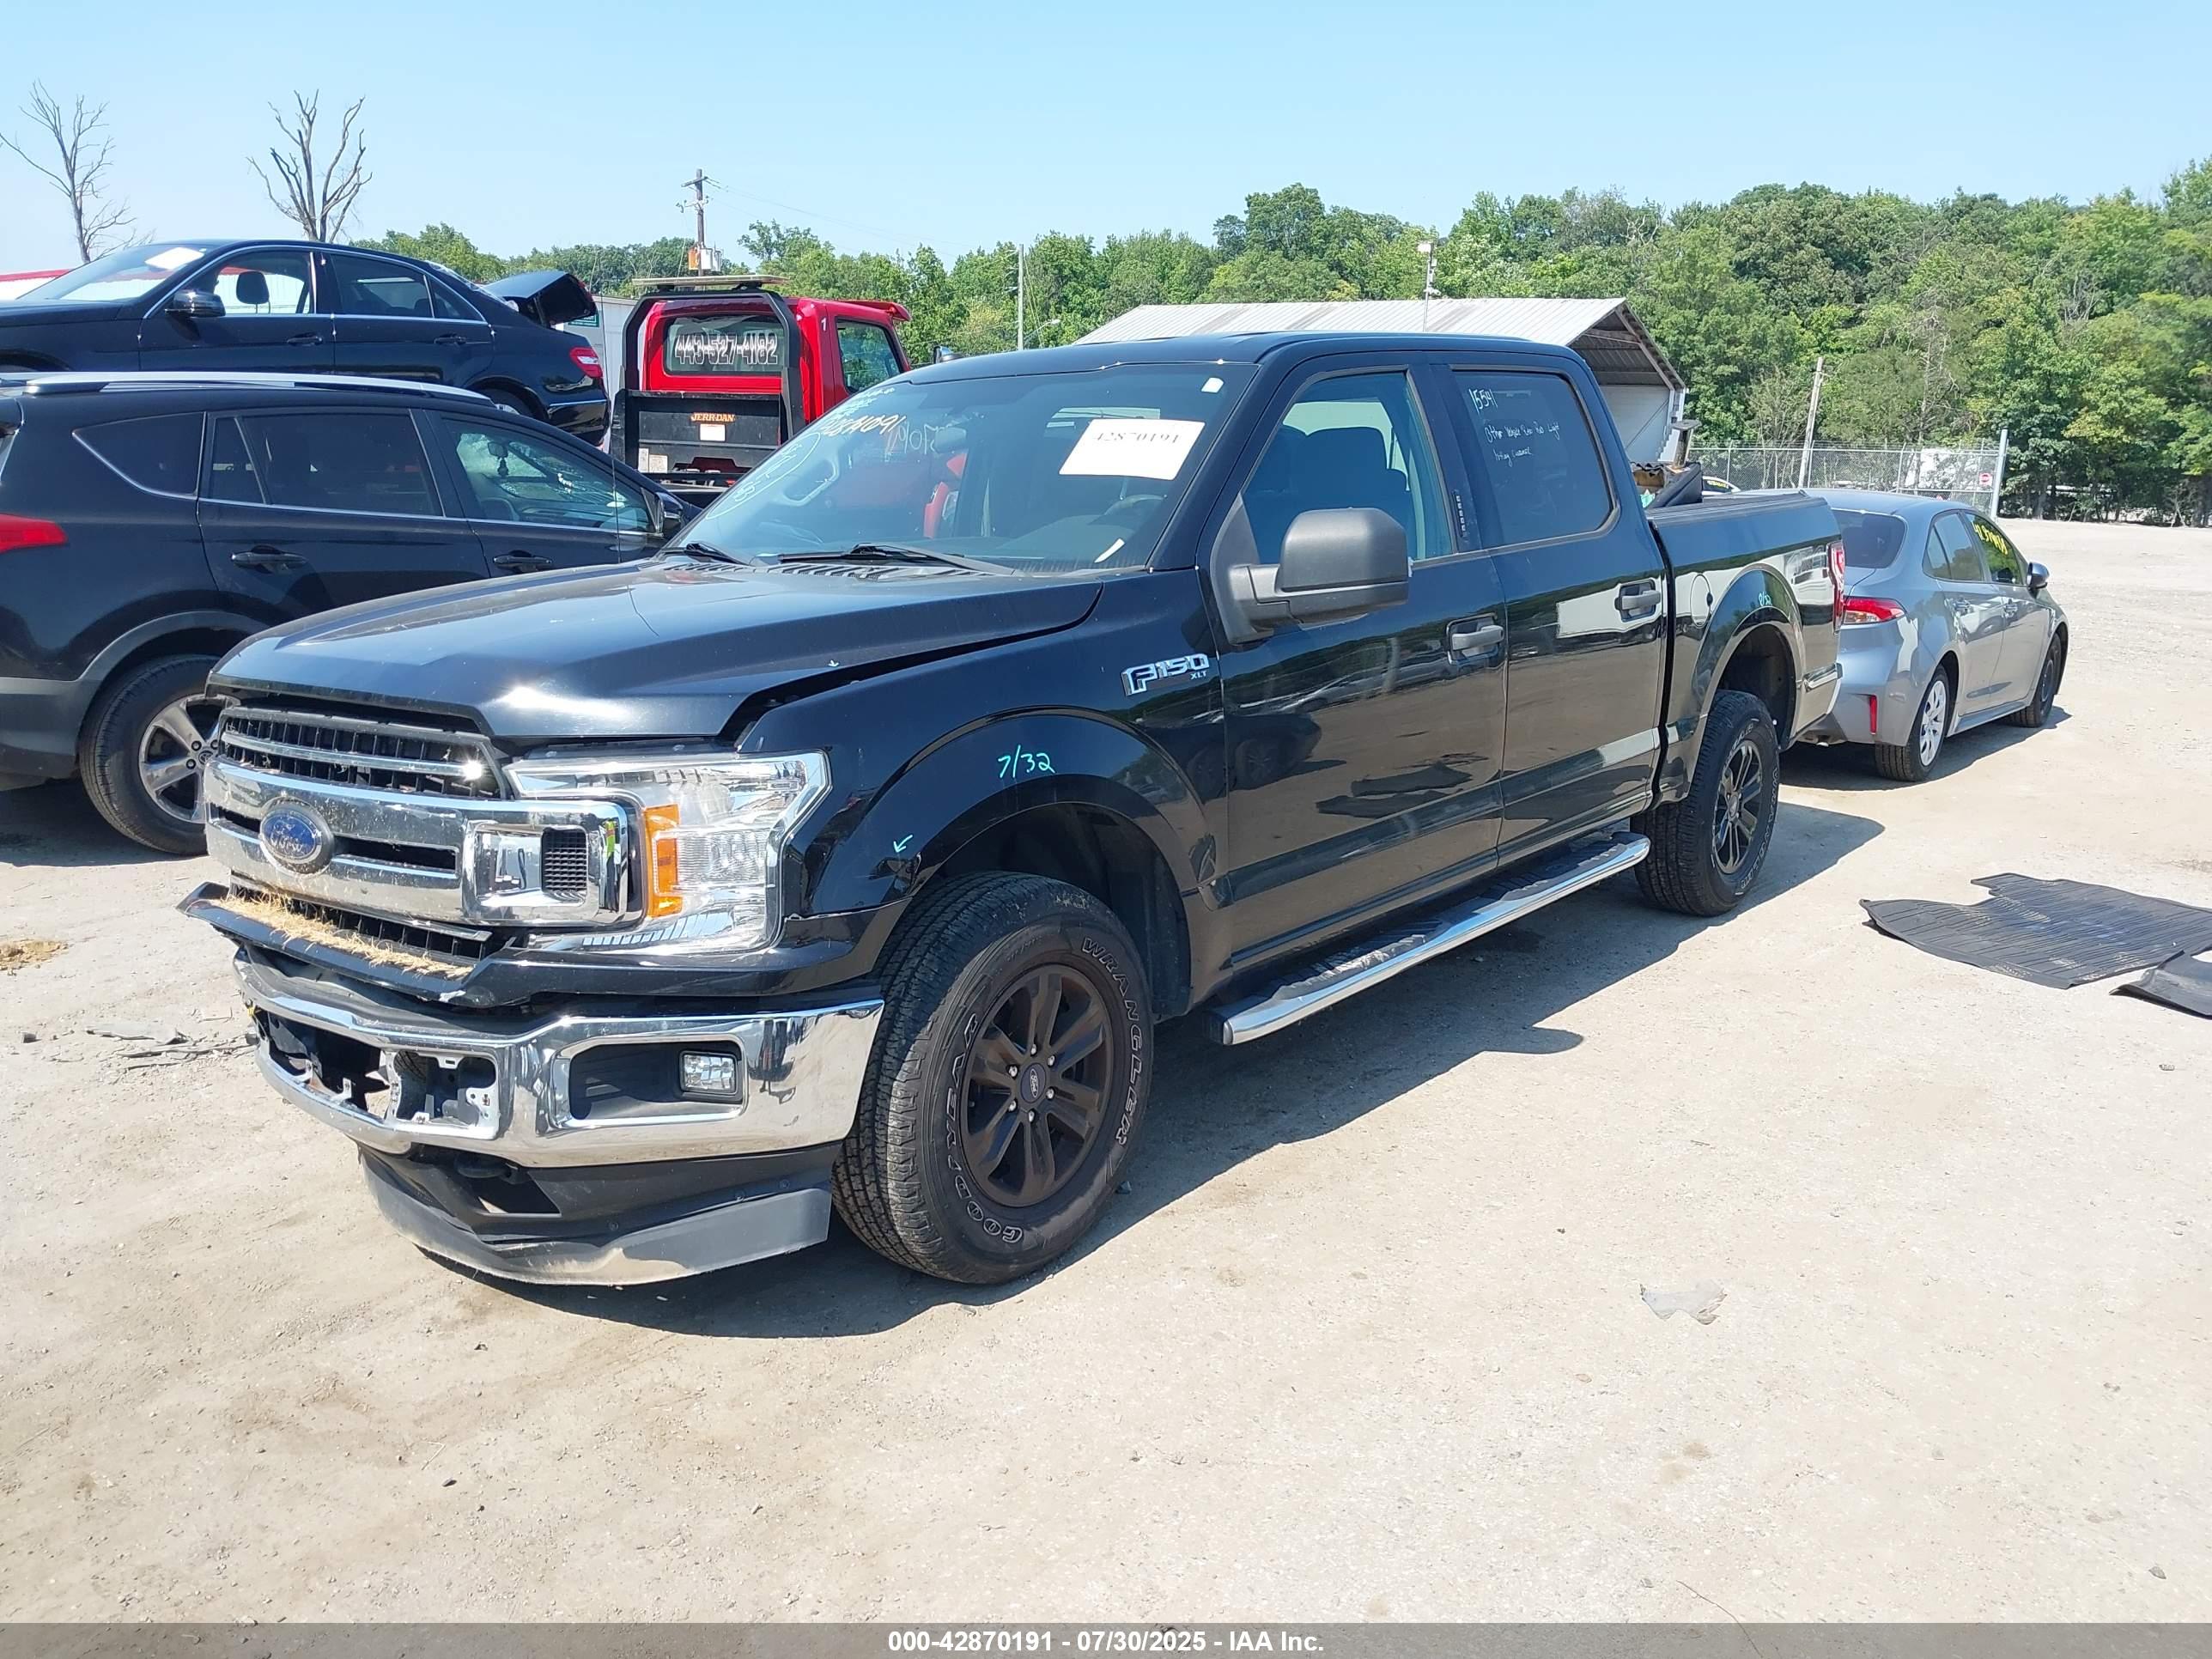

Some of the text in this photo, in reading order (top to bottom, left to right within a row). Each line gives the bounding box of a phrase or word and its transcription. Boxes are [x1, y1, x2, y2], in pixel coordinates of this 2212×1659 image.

[674, 334, 778, 365] 443-527-4182
[690, 410, 735, 422] JERR-DAN
[1189, 670, 1207, 680] XLT
[998, 744, 1056, 779] 7/32
[1081, 936, 1142, 1146] WRANGLER
